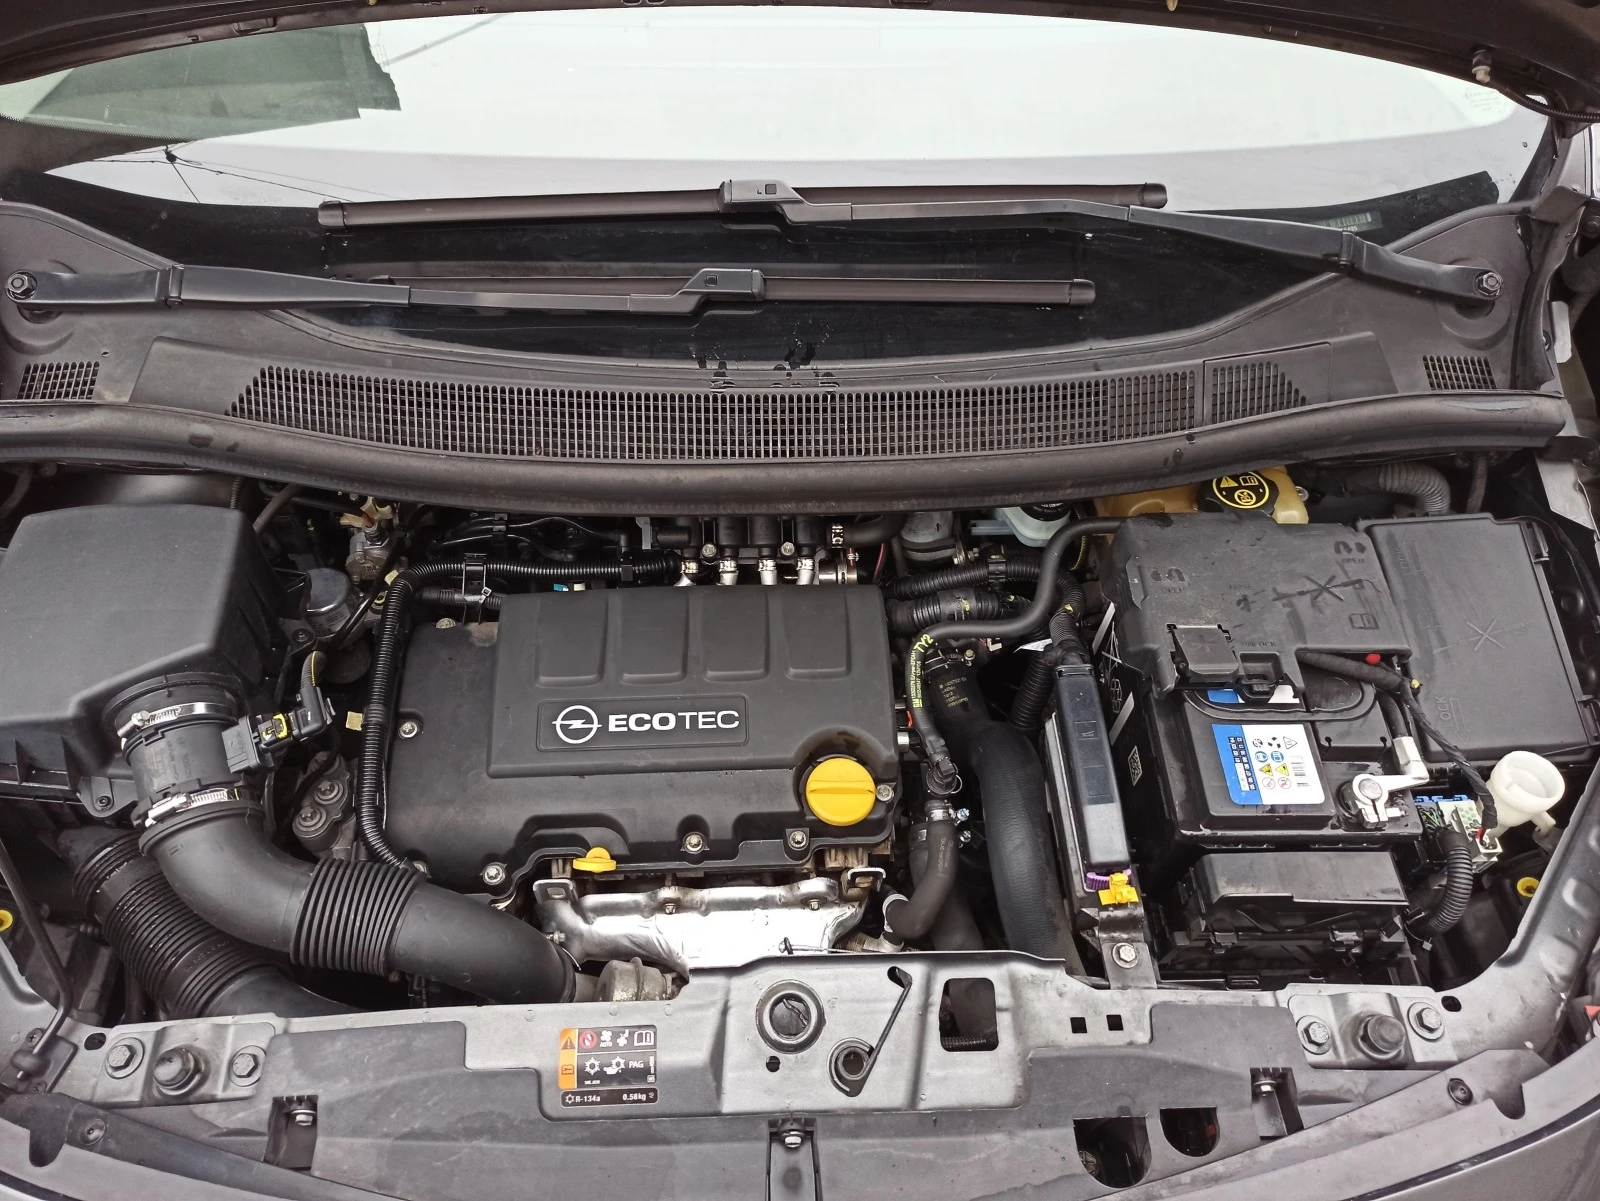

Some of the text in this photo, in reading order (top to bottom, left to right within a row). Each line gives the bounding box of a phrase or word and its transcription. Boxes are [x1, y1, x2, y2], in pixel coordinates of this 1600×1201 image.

[913, 634, 934, 652] TY2
[912, 699, 922, 708] GM
[1434, 696, 1453, 728] LOCK
[608, 711, 740, 732] ECOTEC
[628, 1060, 644, 1069] PAG
[575, 1095, 601, 1103] R-134a
[622, 1093, 647, 1102] 0.58kg
